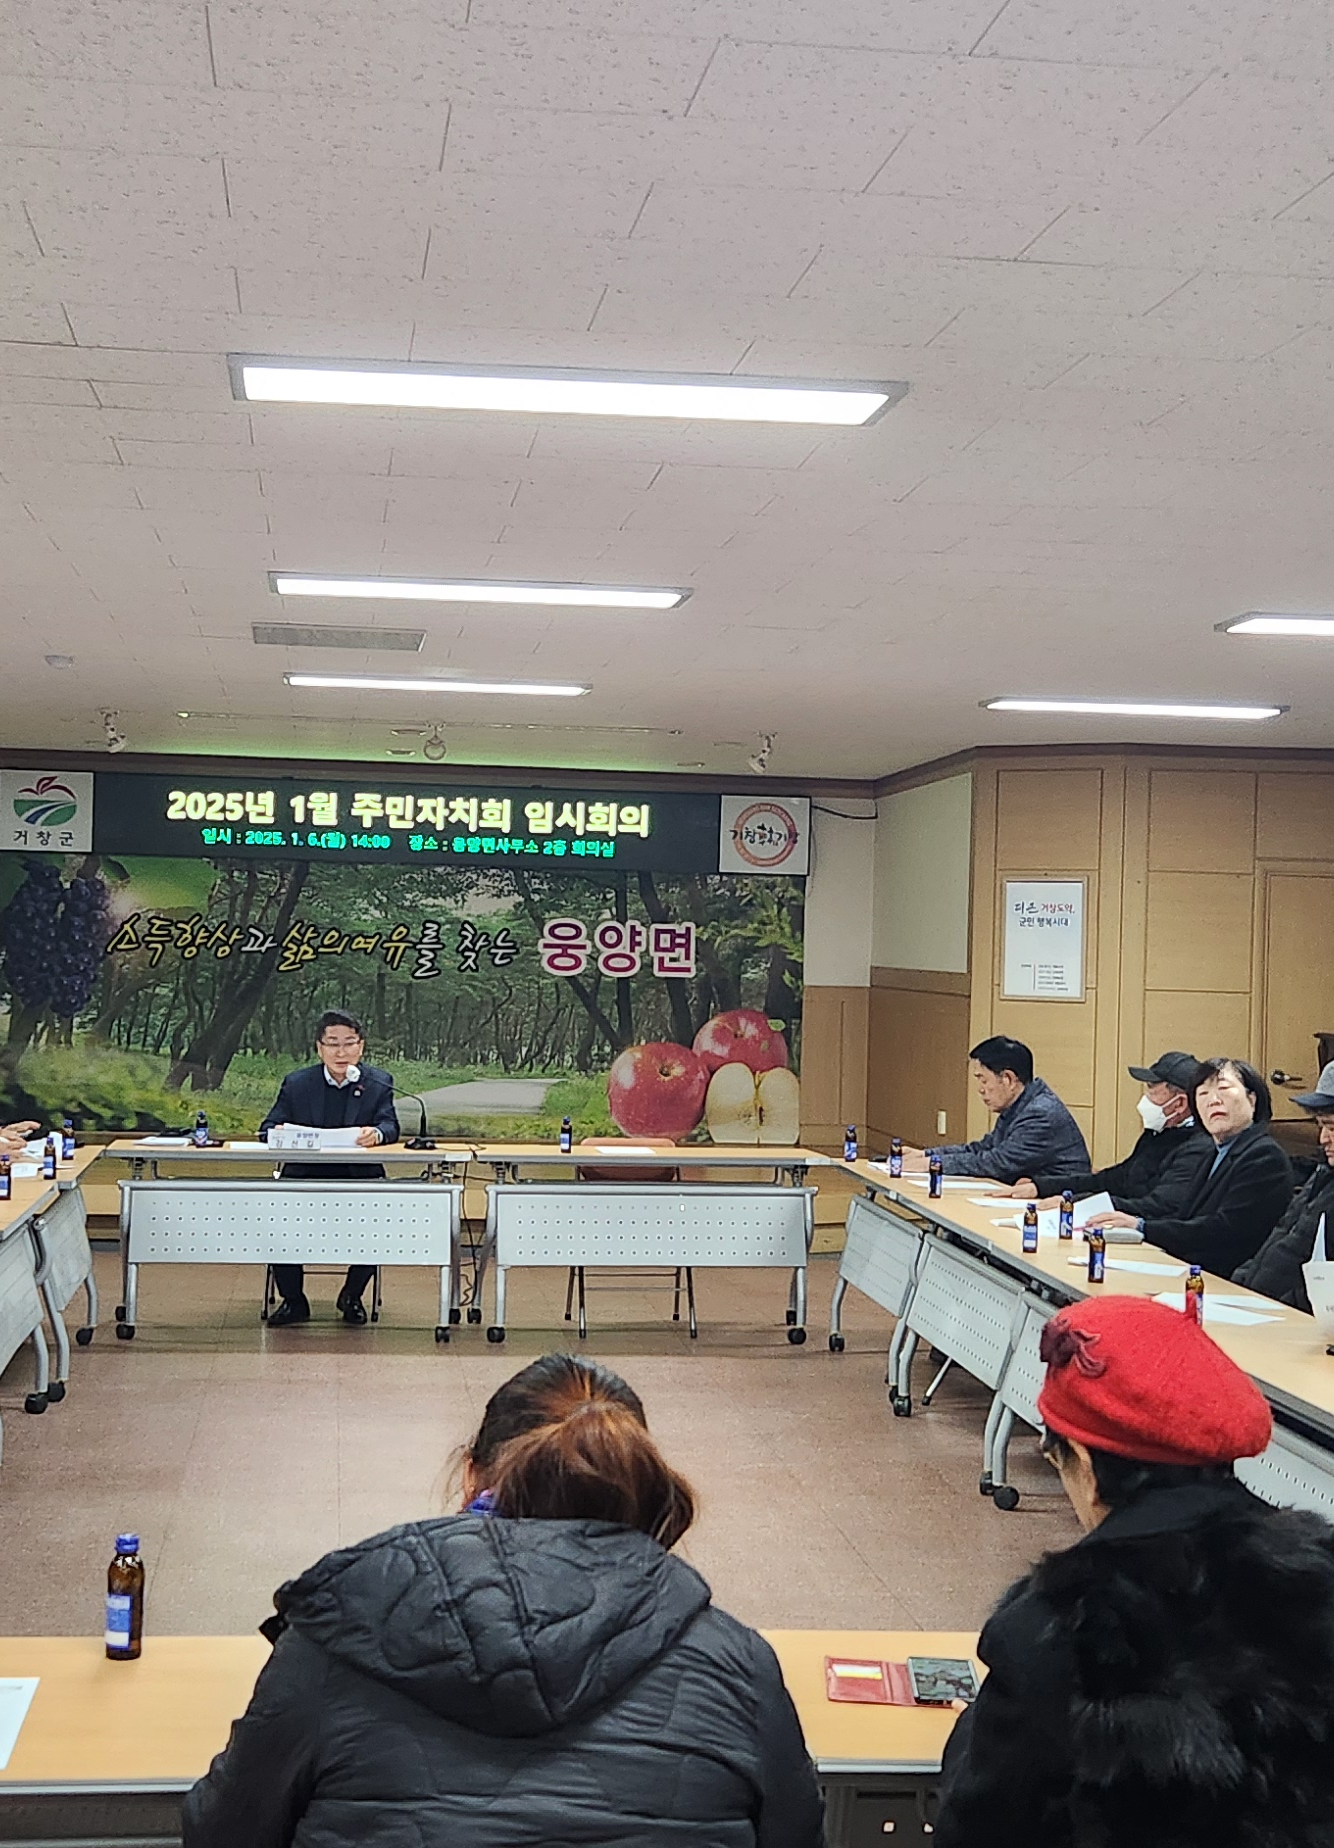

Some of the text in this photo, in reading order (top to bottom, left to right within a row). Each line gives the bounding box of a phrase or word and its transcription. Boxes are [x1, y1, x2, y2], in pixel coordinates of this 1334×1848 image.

[166, 790, 650, 838] 2025년 1월 주민자치회 임시회의
[12, 830, 76, 847] 거창군
[201, 828, 232, 846] 일시
[244, 830, 287, 846] 2025.
[350, 833, 392, 849] 14:00
[408, 834, 439, 852] 장소
[571, 840, 616, 858] 회의실
[105, 913, 279, 968] 소득향상과
[458, 919, 518, 973] 찾는
[539, 919, 695, 977] 웅양면
